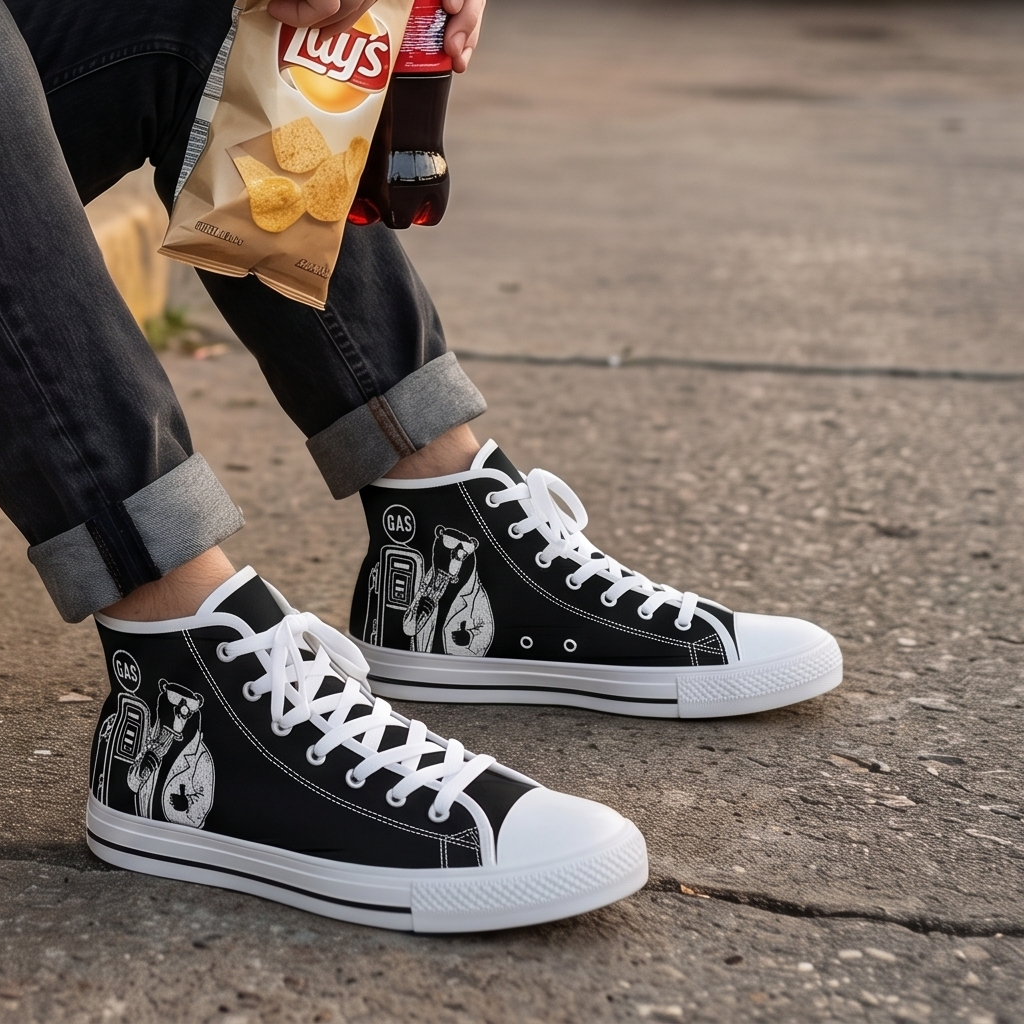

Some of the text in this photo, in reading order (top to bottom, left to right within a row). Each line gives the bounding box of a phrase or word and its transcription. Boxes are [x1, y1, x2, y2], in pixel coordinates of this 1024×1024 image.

[283, 25, 389, 81] Lay's
[387, 514, 412, 532] GAS
[116, 659, 138, 682] GAS
